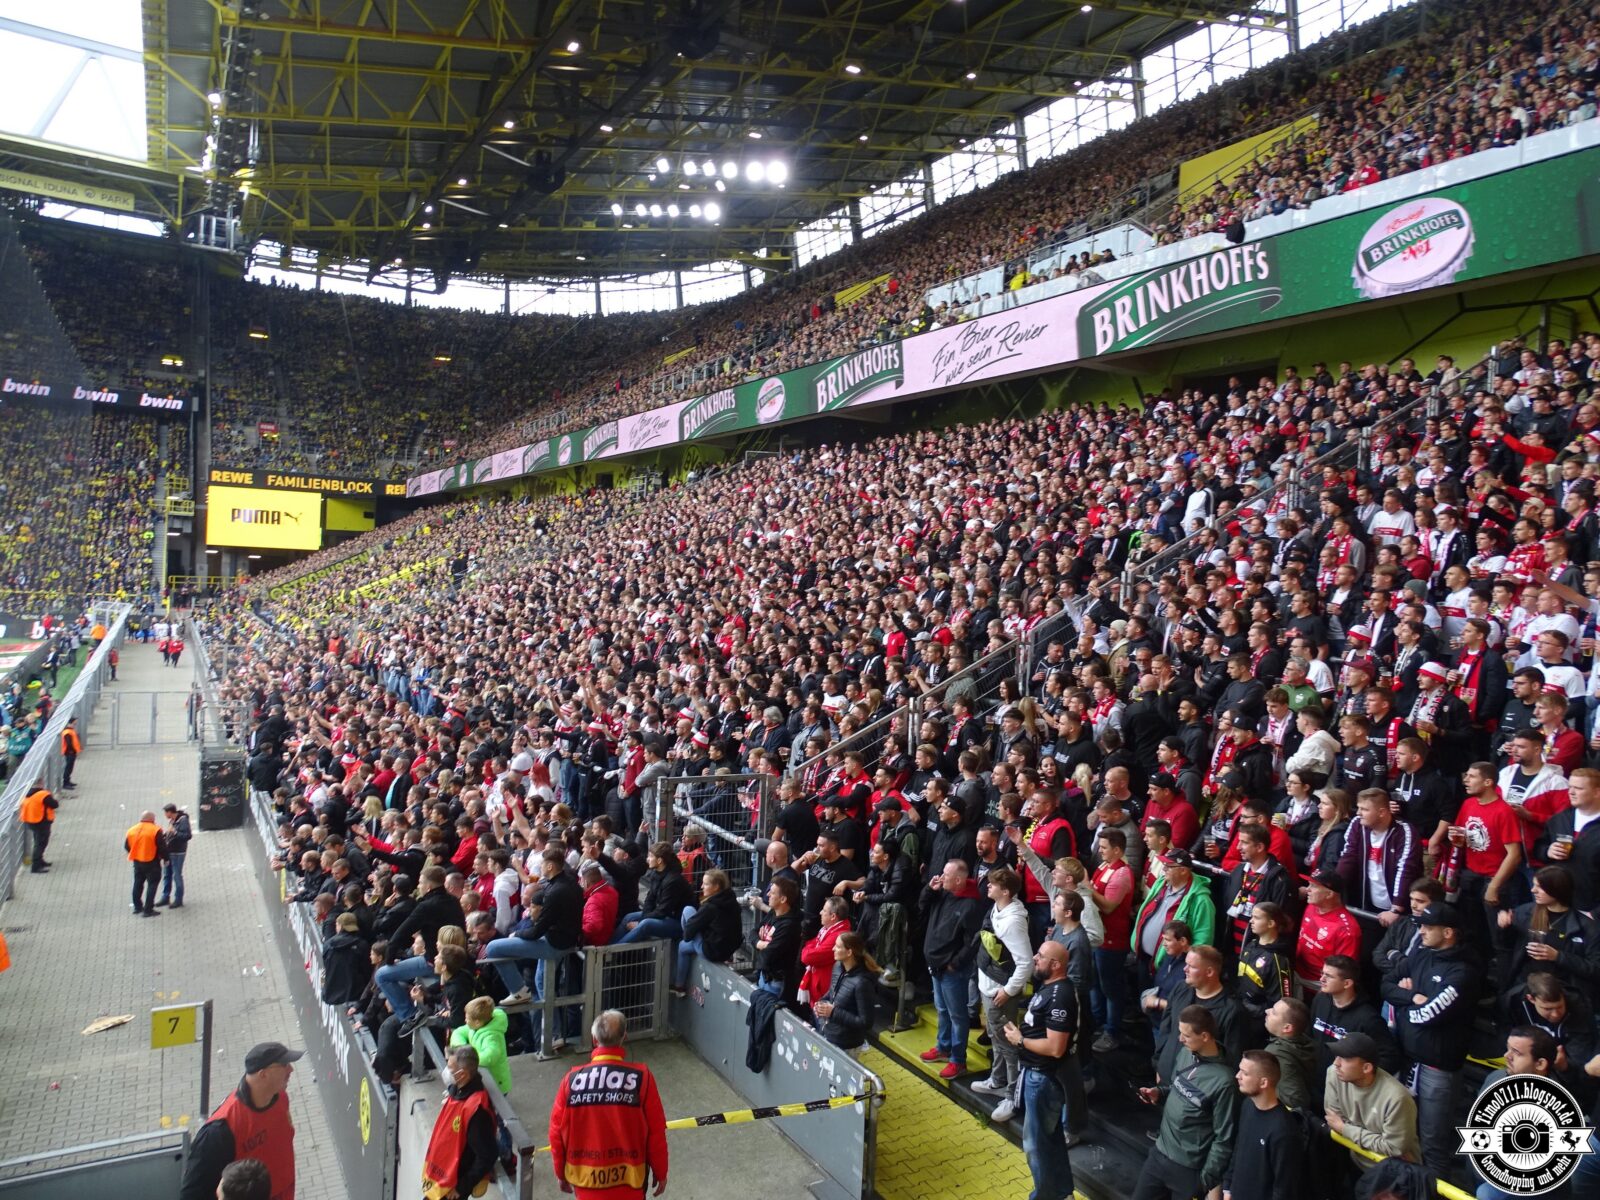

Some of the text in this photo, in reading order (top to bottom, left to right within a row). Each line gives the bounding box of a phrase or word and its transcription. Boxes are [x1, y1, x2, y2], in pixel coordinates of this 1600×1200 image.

[43, 183, 79, 195] IDUNA
[101, 192, 130, 206] PARK
[932, 321, 997, 383] Ein Bier
[945, 321, 1049, 385] wie sein Revier
[3, 378, 51, 396] bwin
[73, 386, 119, 403] bwin
[139, 393, 184, 410] bwin
[211, 470, 373, 494] REWE FAMILIENBLOCK
[231, 508, 281, 525] PUMA
[168, 1016, 180, 1035] 7
[328, 1005, 350, 1085] PARK
[570, 1067, 639, 1091] atlas
[570, 1091, 634, 1105] SAFETY SHOES
[591, 1165, 628, 1185] 10/37
